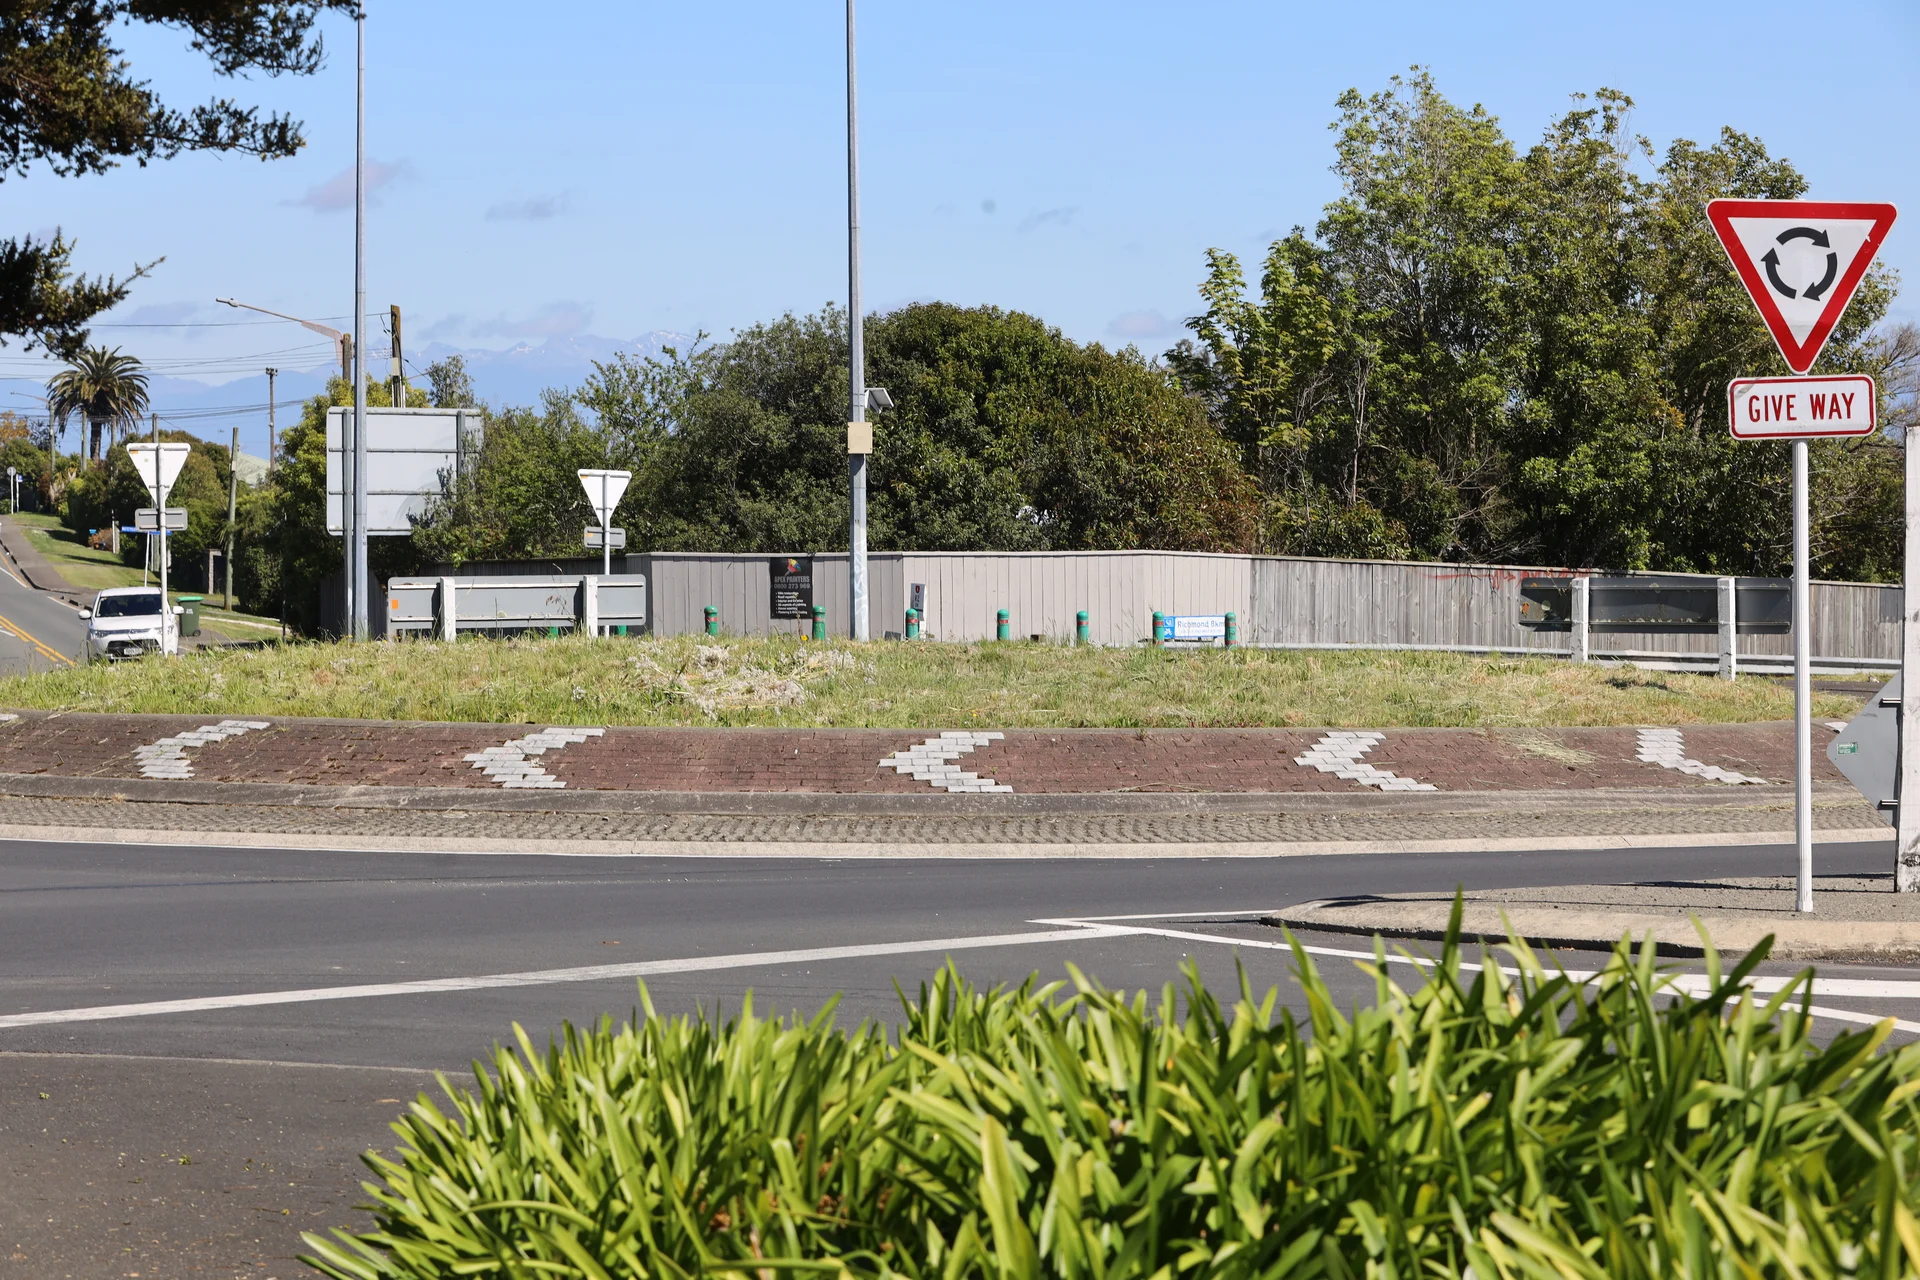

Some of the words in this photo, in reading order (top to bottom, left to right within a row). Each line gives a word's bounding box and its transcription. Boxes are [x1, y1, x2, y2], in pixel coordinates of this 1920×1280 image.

[1748, 394, 1797, 423] GIVE
[1809, 392, 1855, 420] WAY
[1178, 620, 1209, 628] Richmond
